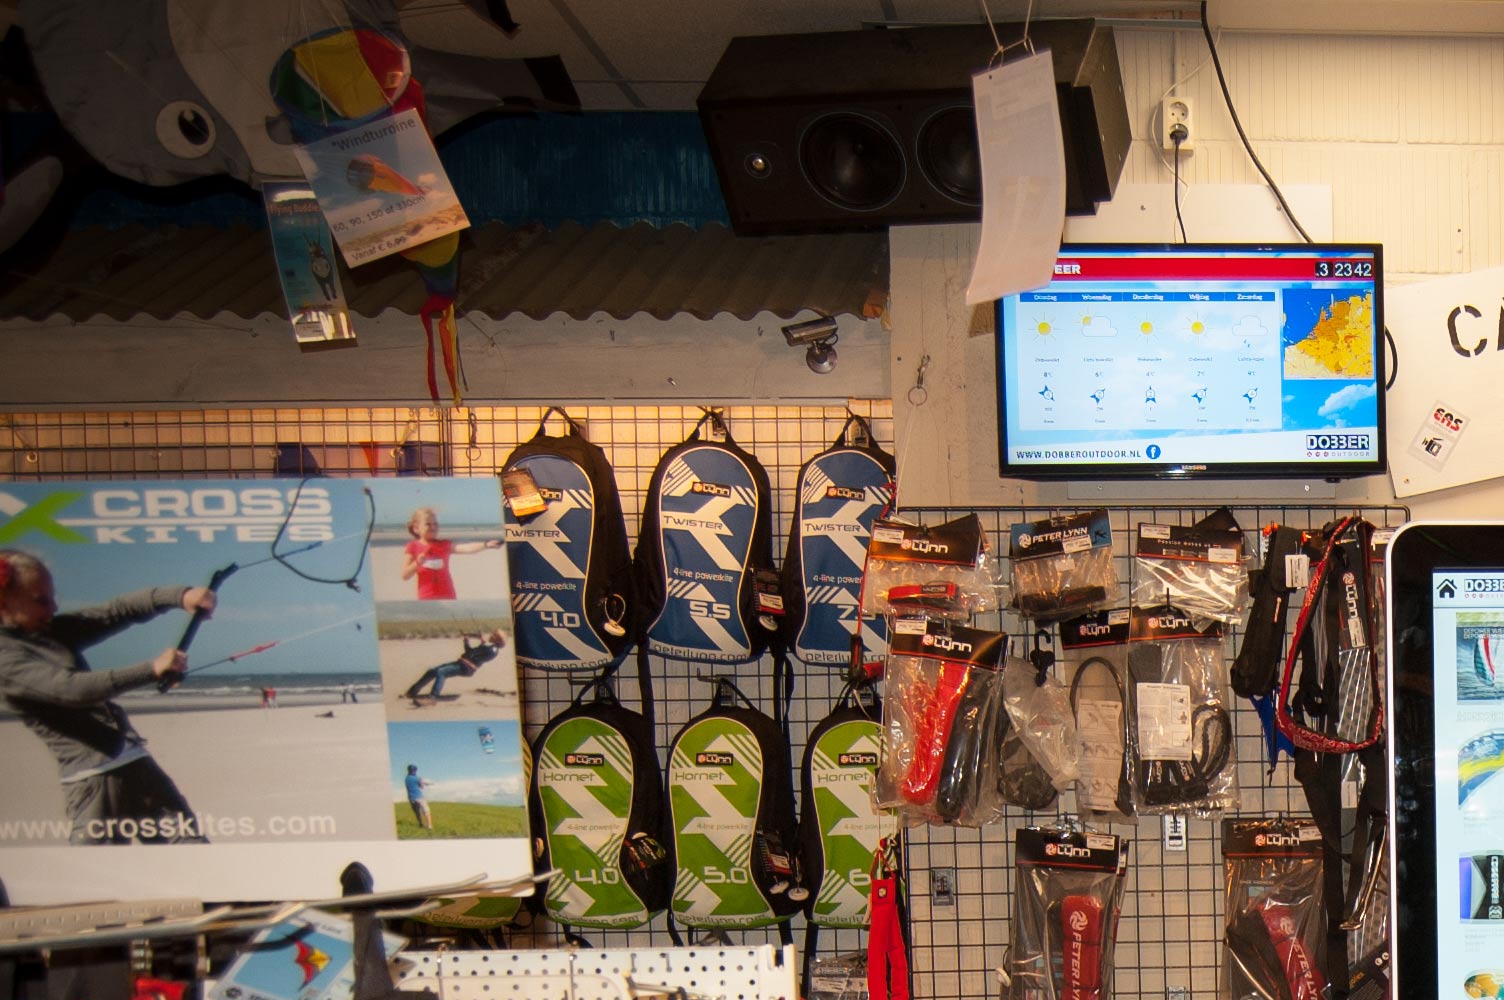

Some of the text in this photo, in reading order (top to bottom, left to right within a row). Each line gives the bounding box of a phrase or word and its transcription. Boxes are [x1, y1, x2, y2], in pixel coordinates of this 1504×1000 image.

[1054, 264, 1081, 275] EER
[1334, 263, 1353, 277] 23
[1354, 263, 1372, 277] 42
[92, 487, 333, 518] CROSS
[663, 516, 723, 530] TWISTER
[804, 523, 862, 533] TWISTER
[96, 525, 335, 544] KITES
[505, 529, 561, 539] TWISTER
[1032, 531, 1061, 544] PETER
[1062, 526, 1088, 539] LYNN
[837, 575, 863, 585] power
[689, 600, 731, 620] 5.5
[540, 611, 581, 628] 4.0
[543, 772, 596, 782] Hornet
[675, 771, 724, 781] Hornet
[817, 772, 870, 783] Hornet
[0, 812, 337, 841] www.crosskites.com
[575, 868, 620, 885] 4.0
[703, 866, 749, 884] 5.0
[1070, 932, 1082, 980] PETER
